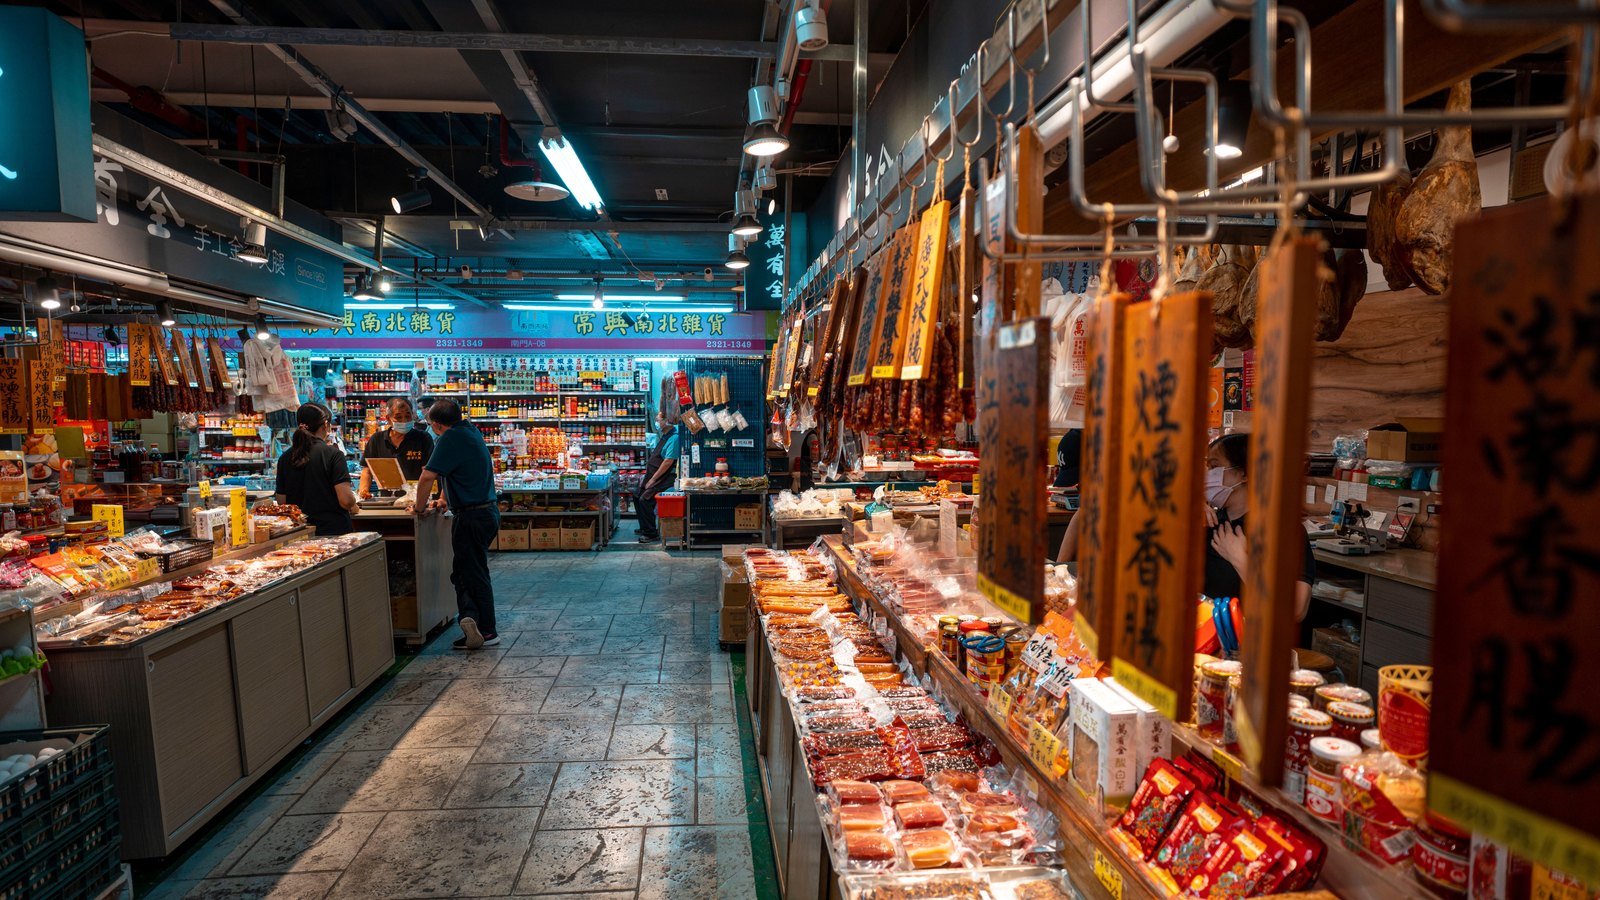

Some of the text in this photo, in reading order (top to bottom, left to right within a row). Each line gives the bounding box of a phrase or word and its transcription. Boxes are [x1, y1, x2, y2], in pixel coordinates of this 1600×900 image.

[194, 224, 286, 276] 手工金腿
[764, 223, 785, 298] 萬有全
[301, 310, 456, 335] 南北雜貨
[573, 311, 726, 335] 常興南北雜貨
[435, 338, 483, 348] 2321-1349
[706, 340, 752, 349] 2321-1349
[33, 369, 51, 425] 煙燻辣腸
[1124, 360, 1181, 672] 煙燻香腸
[1115, 722, 1128, 755] 萬有全
[1151, 720, 1163, 753] 萬有全
